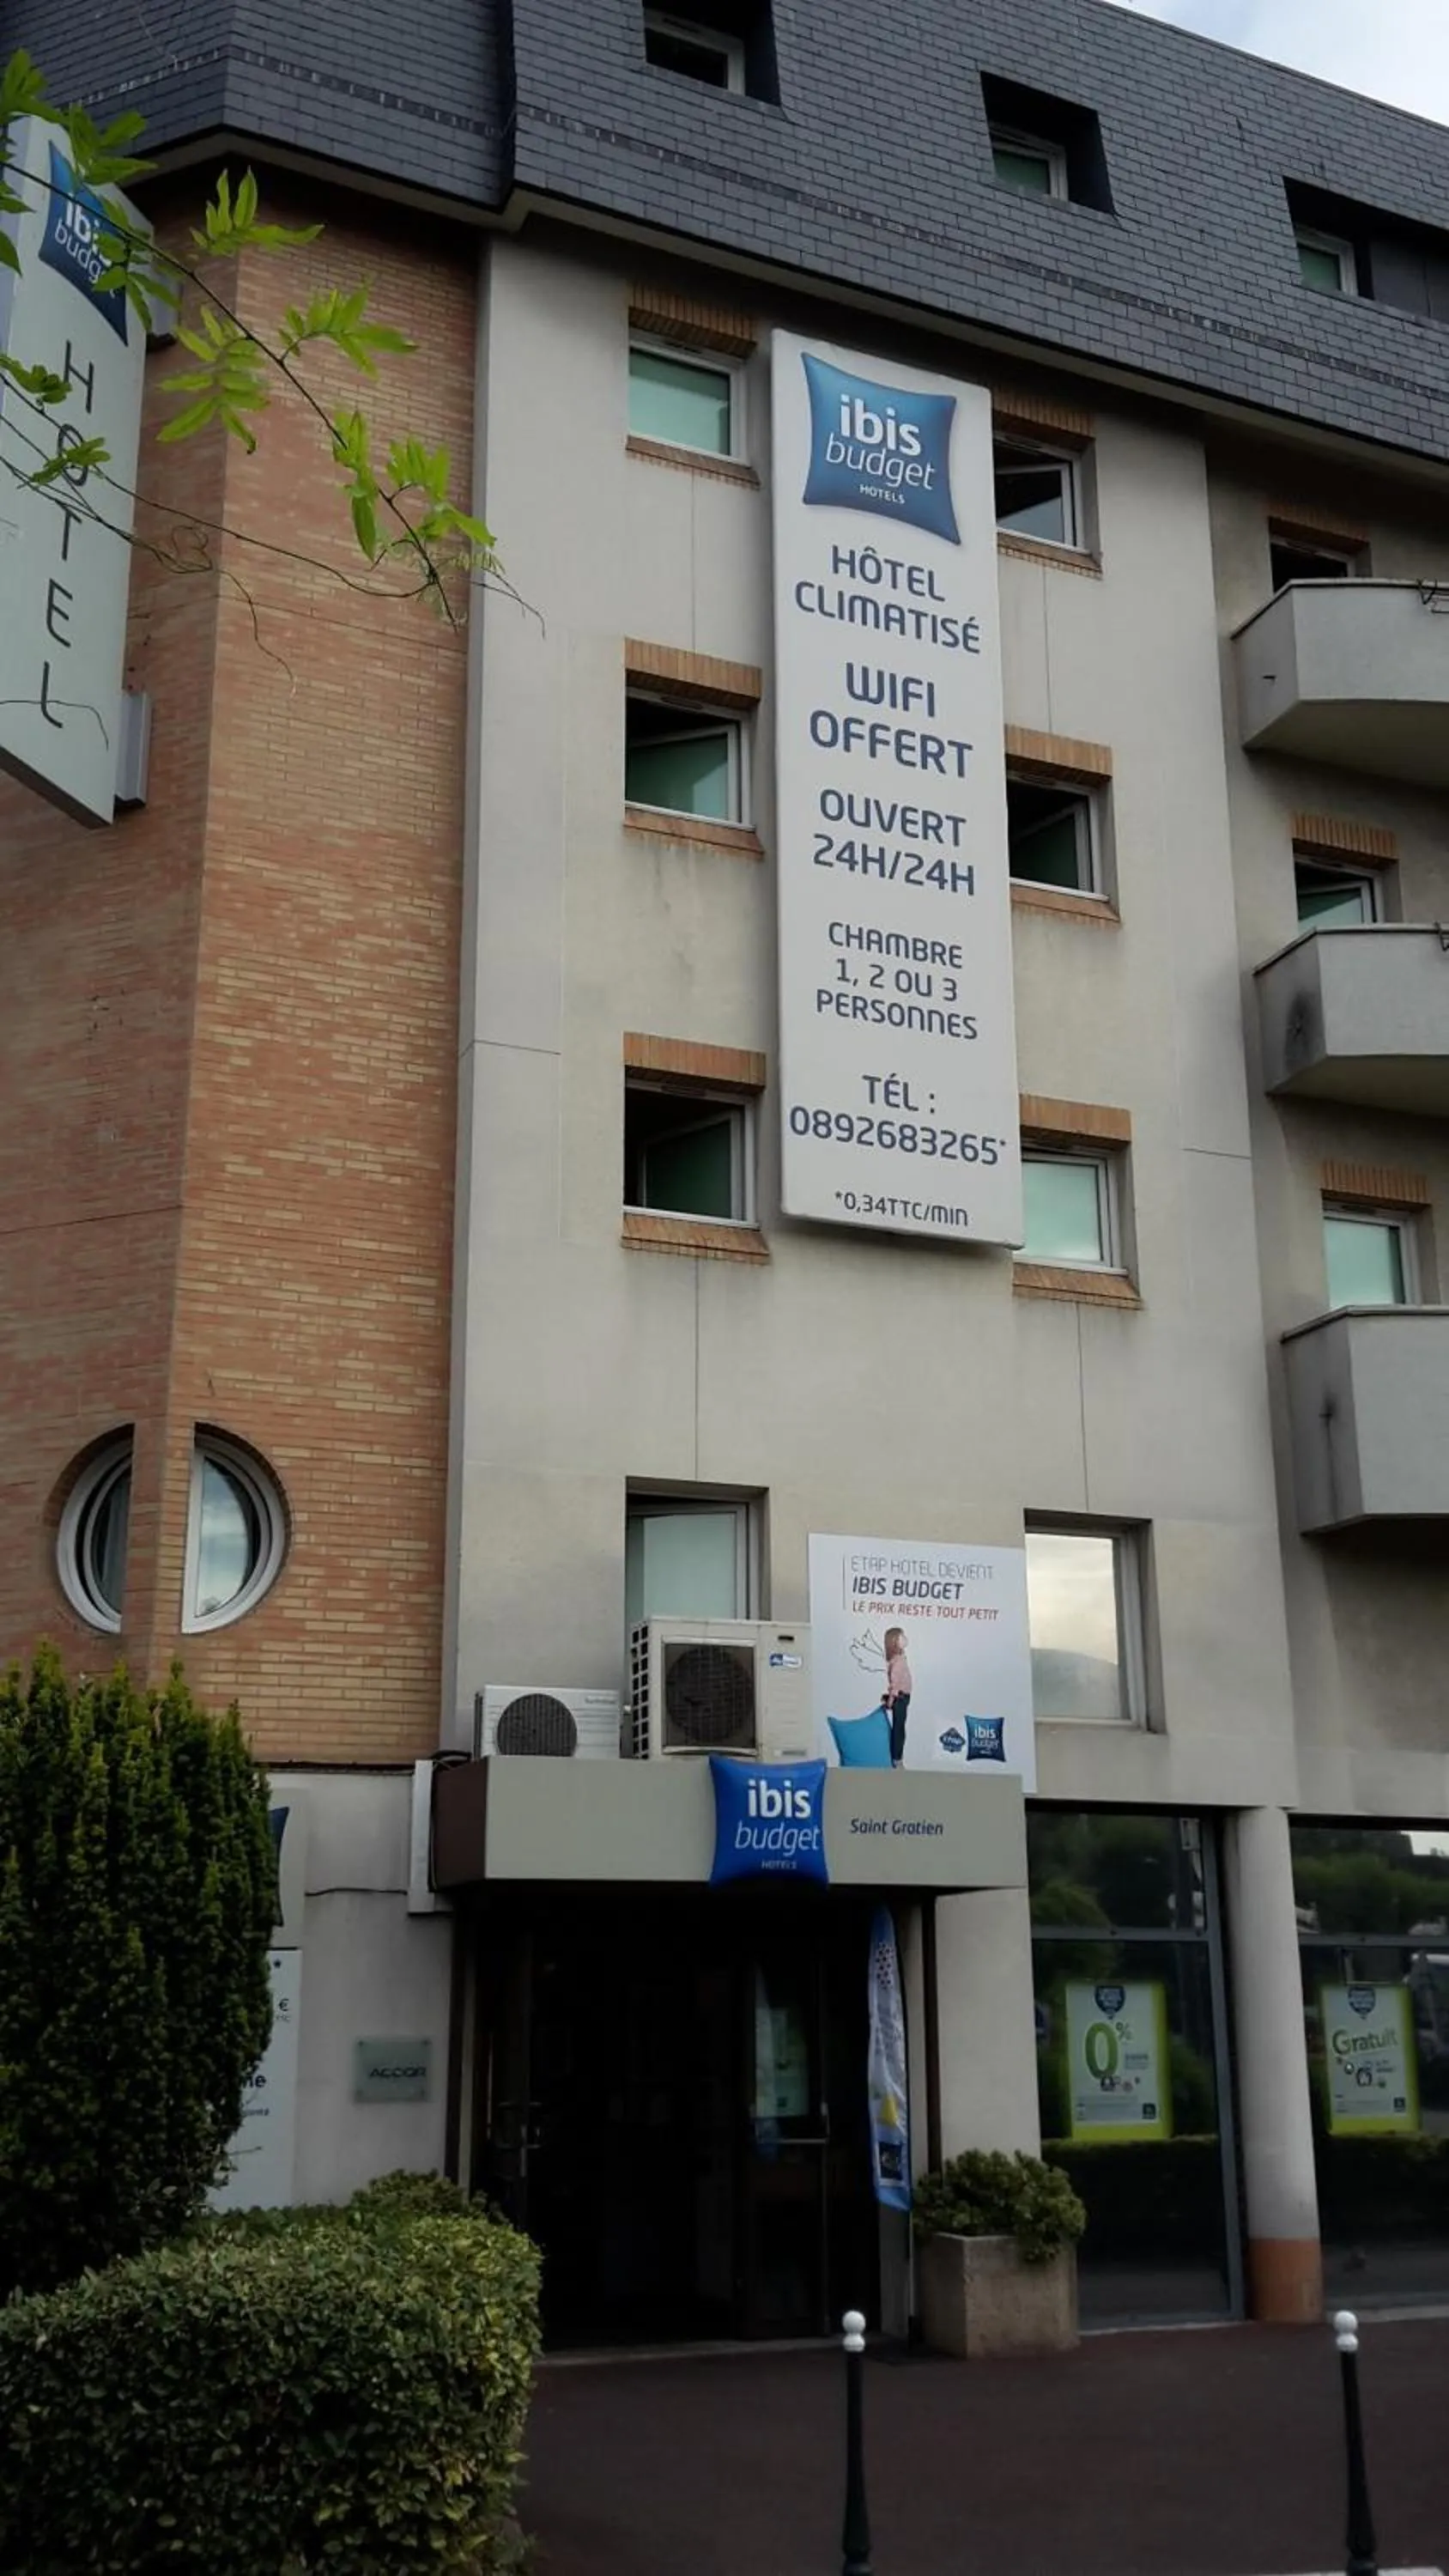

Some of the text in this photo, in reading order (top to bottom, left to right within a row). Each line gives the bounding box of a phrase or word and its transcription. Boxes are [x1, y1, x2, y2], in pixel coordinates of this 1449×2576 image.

[67, 192, 112, 267] ibi
[55, 219, 115, 299] budg
[840, 393, 922, 456] ibis
[825, 433, 935, 490] budget
[859, 483, 905, 504] HOTELS
[41, 340, 94, 728] HOTEL
[832, 545, 945, 602] HÔTEL
[795, 581, 979, 653] CLIMATISÉ
[846, 662, 935, 718] WIFI
[809, 710, 973, 778] OFFERT
[820, 789, 967, 848] OUVERT
[814, 834, 974, 896] 24H/24H
[828, 921, 963, 969] CHAMBRE
[870, 964, 885, 988] 2
[894, 969, 932, 998] OU
[943, 978, 957, 1002] 3
[816, 988, 978, 1040] PERSONNES
[852, 1556, 993, 1579] ETAP HOTEL DEVIENT
[852, 1577, 964, 1600] IBIS BUDGET
[852, 1601, 999, 1620] LE PRIX RESTE TOUT PETIT
[974, 1724, 996, 1738] ibis
[748, 1779, 811, 1820] ibis
[735, 1820, 822, 1856] budget
[851, 1818, 943, 1836] Saint Gratien
[1332, 2028, 1398, 2057] Gratuit
[369, 2067, 427, 2077] ACCOR
